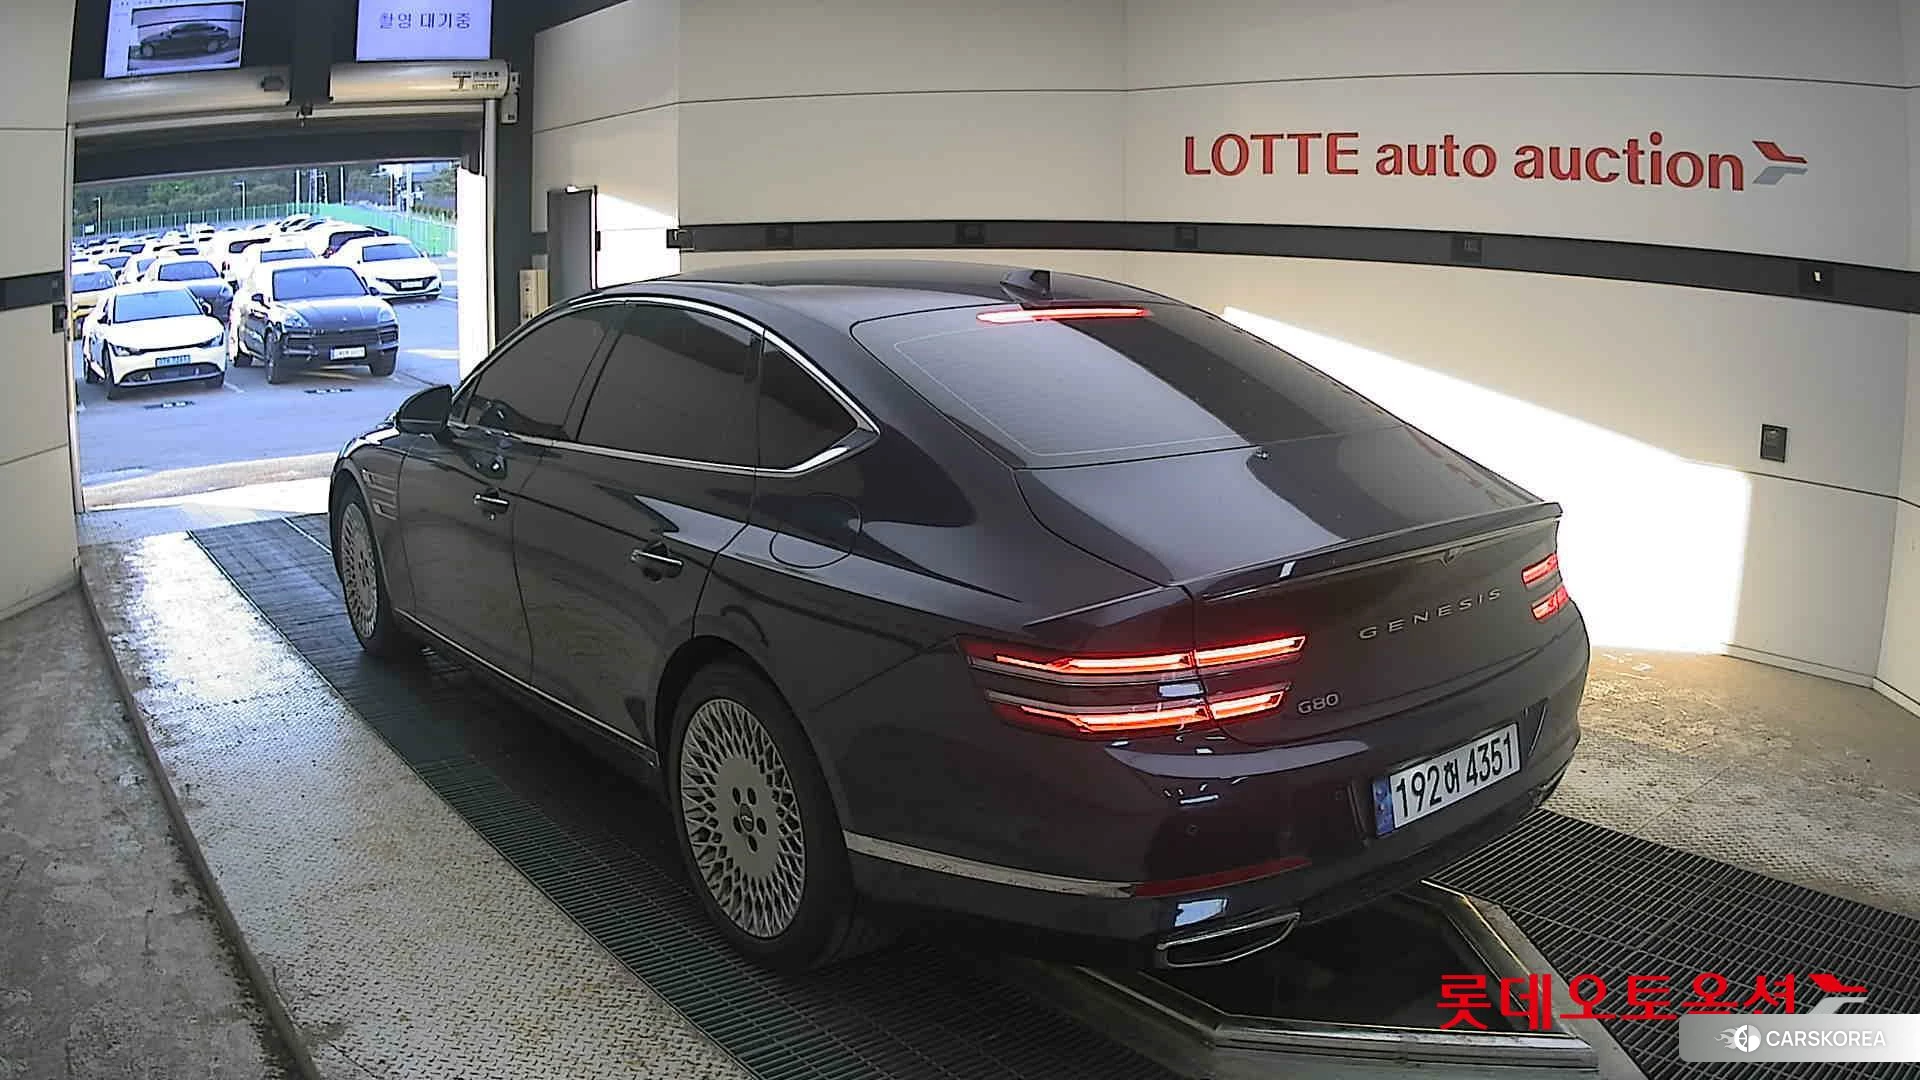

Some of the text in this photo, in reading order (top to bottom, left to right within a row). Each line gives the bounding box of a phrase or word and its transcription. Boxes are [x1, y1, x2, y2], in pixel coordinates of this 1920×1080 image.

[420, 12, 471, 29] 대기중
[1184, 131, 1744, 191] LOTTE auto auction
[1359, 588, 1501, 639] GENESIS
[1298, 693, 1339, 714] G80
[1396, 731, 1513, 818] 192허 4351
